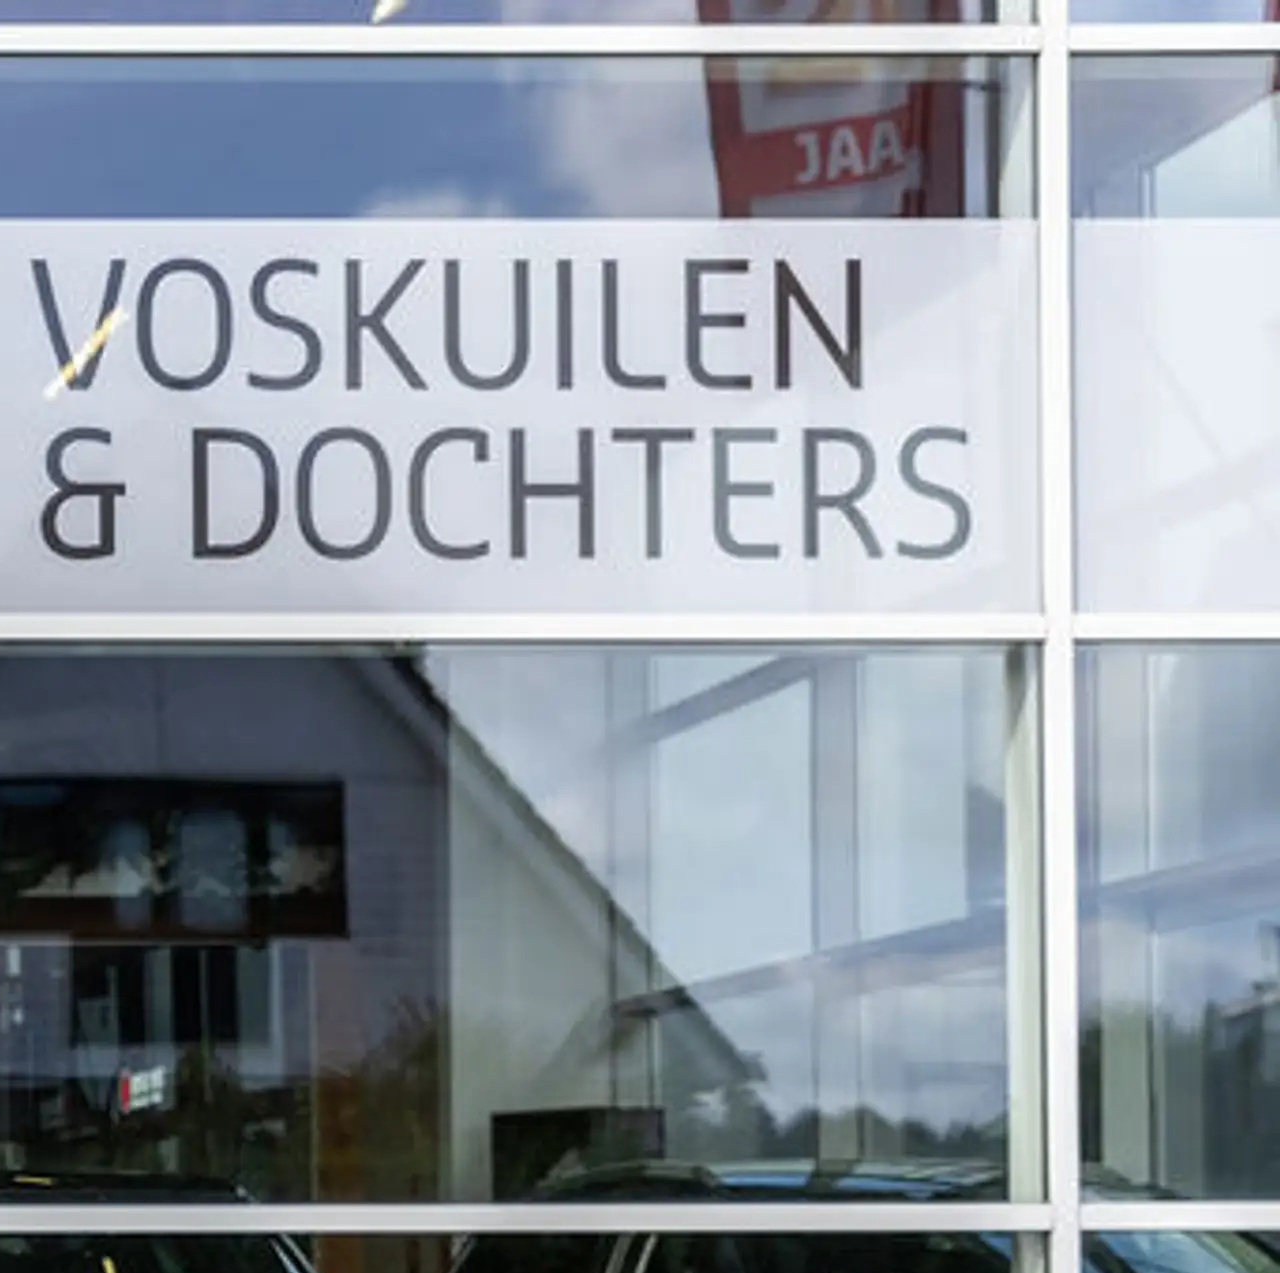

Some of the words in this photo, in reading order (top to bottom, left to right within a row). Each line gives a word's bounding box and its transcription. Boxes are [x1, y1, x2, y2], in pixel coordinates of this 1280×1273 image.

[30, 257, 865, 393] VOSKUILEN
[38, 426, 127, 561] &
[190, 426, 972, 561] DOCHTERS
